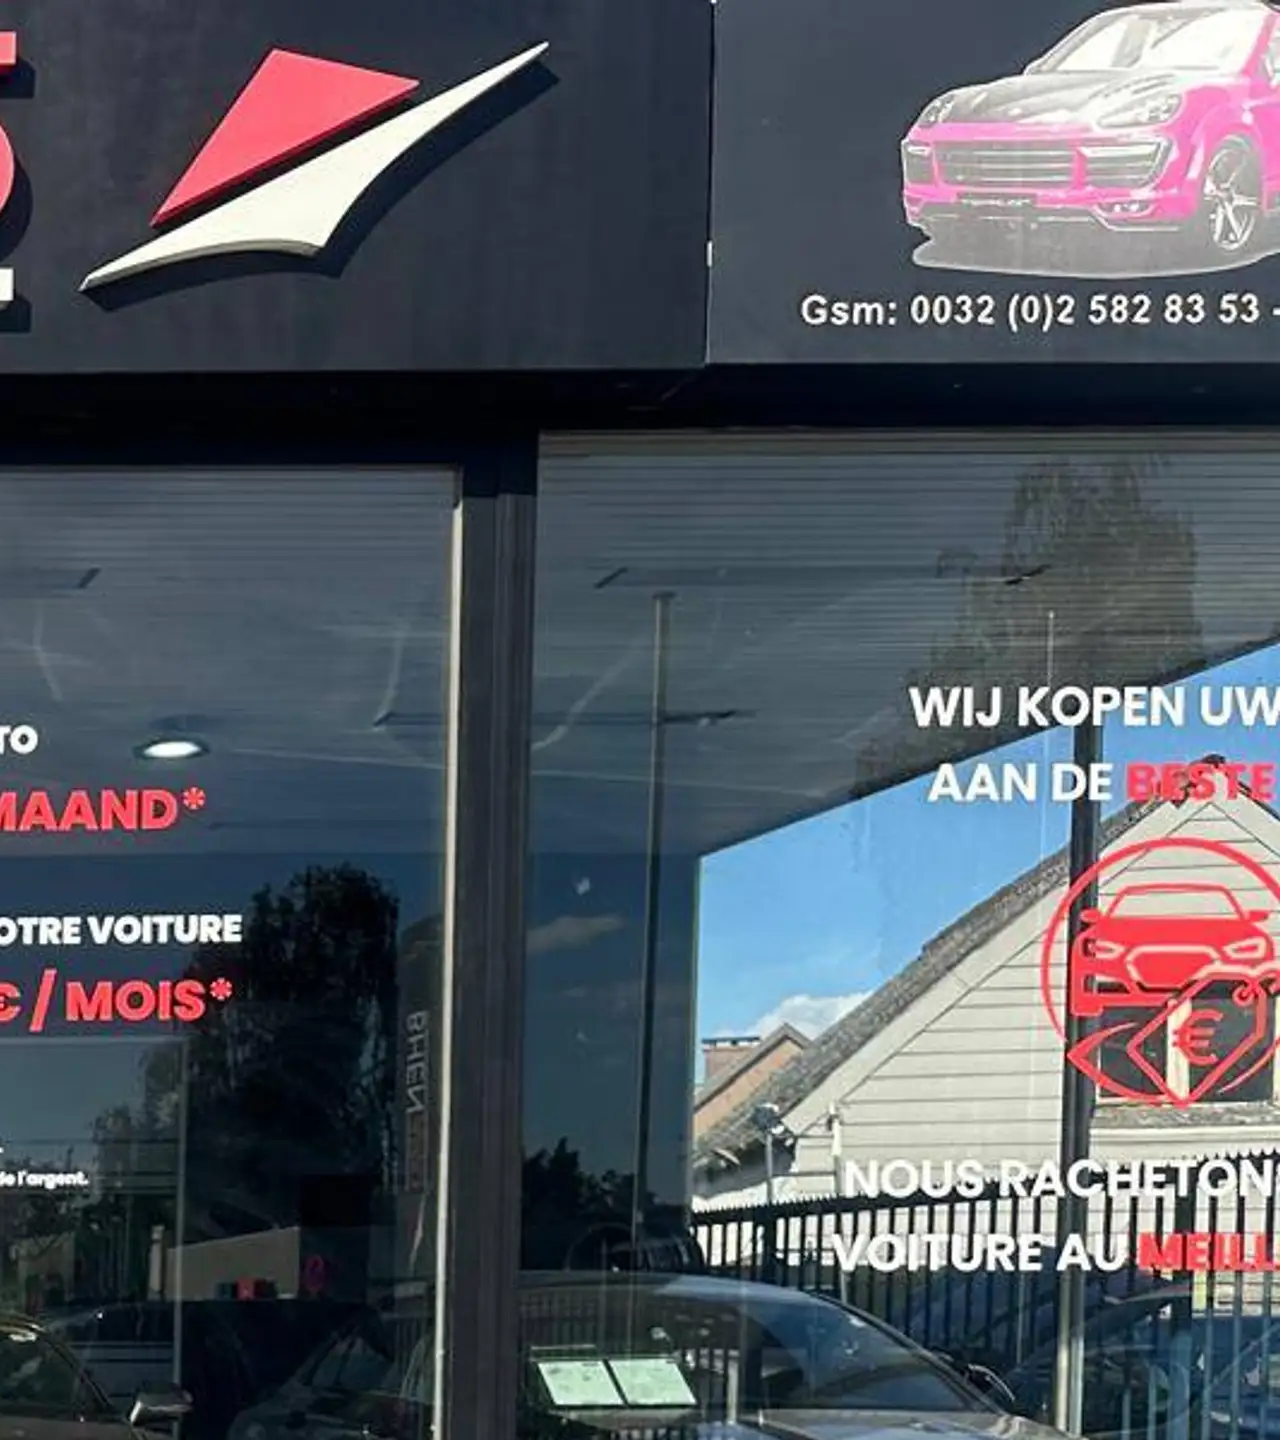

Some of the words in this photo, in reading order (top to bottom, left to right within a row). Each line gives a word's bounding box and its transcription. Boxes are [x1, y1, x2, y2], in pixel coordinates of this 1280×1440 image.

[801, 294, 897, 325] Gsm:
[910, 294, 995, 325] 0032
[1008, 293, 1075, 332] (0)2
[1089, 294, 1151, 325] 582
[1164, 293, 1205, 324] 83
[1219, 293, 1260, 323] 53
[909, 686, 1001, 727] WIJ
[1018, 686, 1185, 727] KOPEN
[928, 763, 1037, 802] AAN
[1052, 763, 1114, 802] DE
[1127, 762, 1276, 803] BESTE
[87, 914, 242, 944] VOITURE
[844, 1159, 985, 1199] NOUS
[1000, 1159, 1280, 1198] RACHETON
[834, 1232, 1043, 1272] VOITURE
[1056, 1232, 1129, 1272] AU
[1137, 1231, 1280, 1272] MEILL
